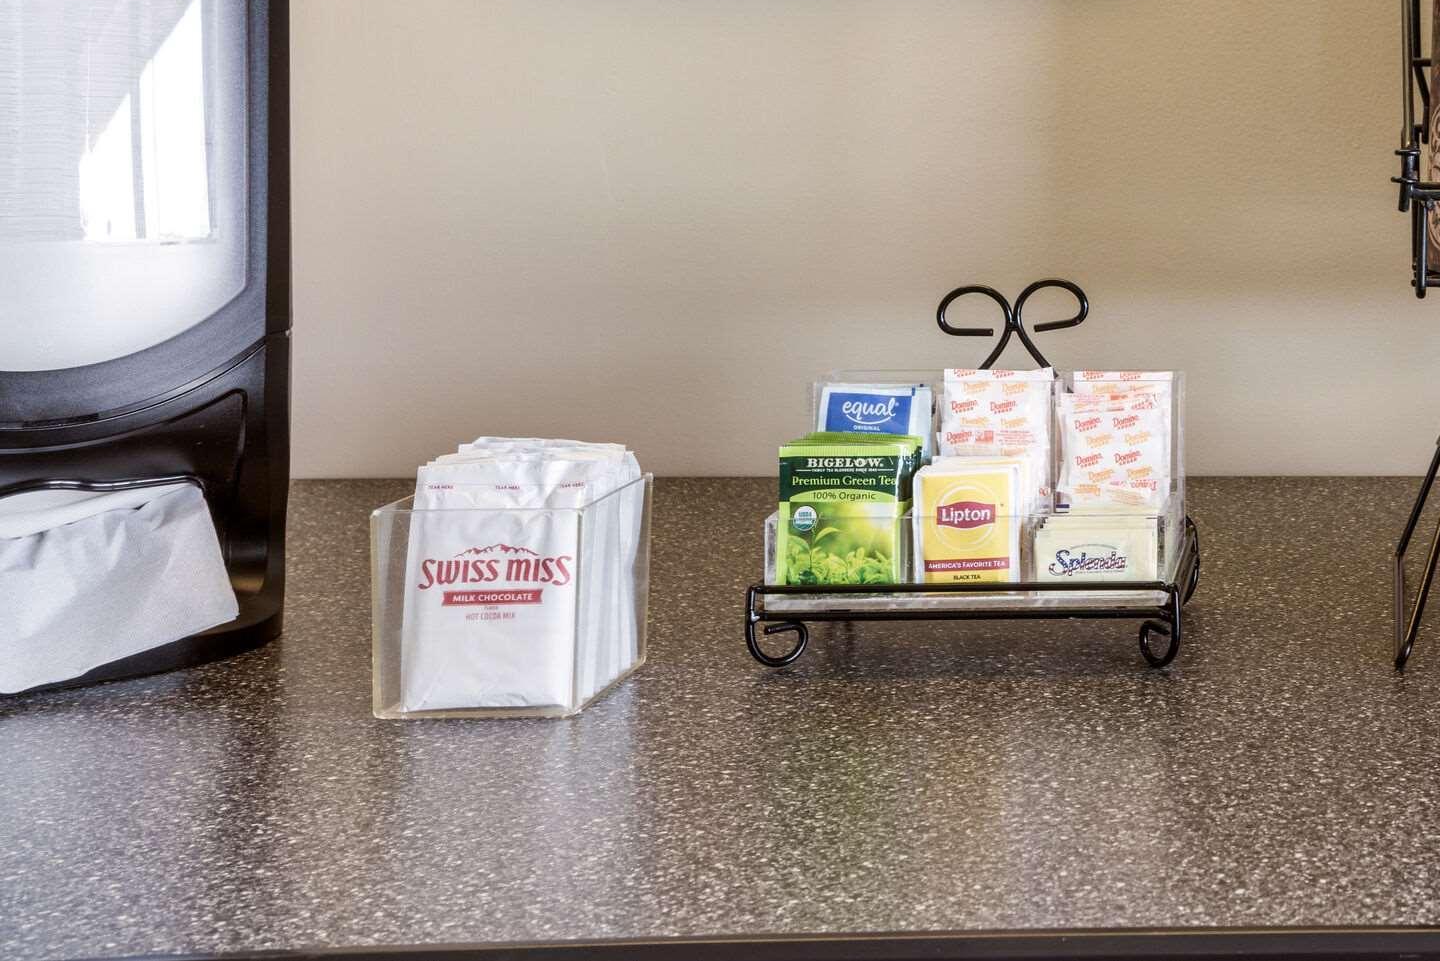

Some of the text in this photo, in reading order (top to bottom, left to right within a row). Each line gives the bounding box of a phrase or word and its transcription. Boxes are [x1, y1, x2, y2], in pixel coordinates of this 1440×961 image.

[842, 397, 897, 420] equal
[806, 457, 883, 468] BIGELOW
[791, 475, 897, 486] Premium Green Tea
[813, 491, 876, 502] 100% Organic
[941, 507, 991, 524] Lipton
[1048, 549, 1127, 576] Splenda
[417, 555, 573, 590] SWISS MISS
[452, 592, 533, 603] MILK CHOCOLATE
